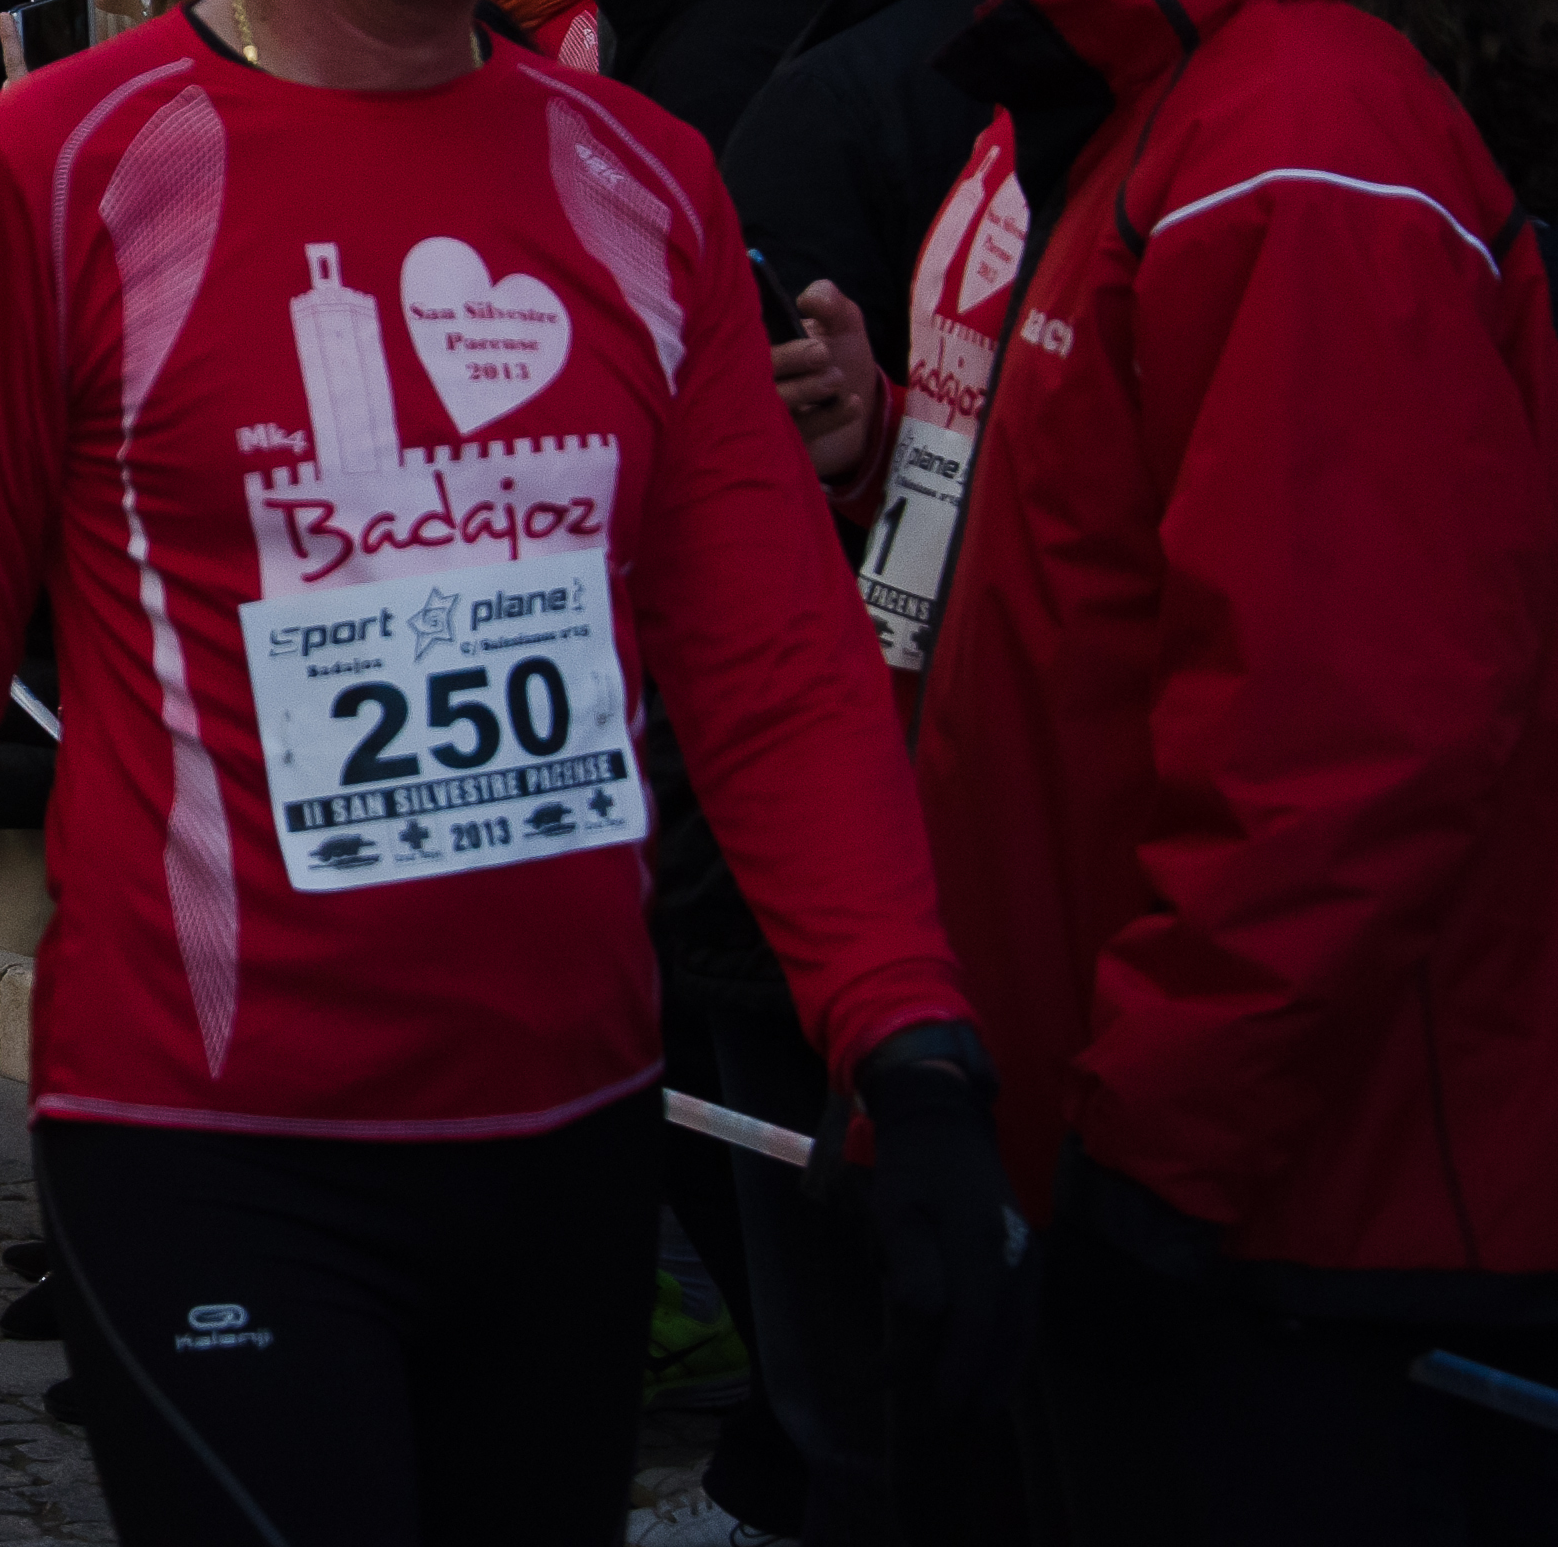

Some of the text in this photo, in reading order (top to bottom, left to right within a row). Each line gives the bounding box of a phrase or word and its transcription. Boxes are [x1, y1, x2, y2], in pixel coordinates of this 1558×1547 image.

[411, 301, 558, 325] San Silvestre
[446, 332, 540, 352] Pacense
[465, 362, 531, 381] 2013
[263, 470, 602, 582] Badajoz
[306, 658, 383, 678] Badajoz
[330, 654, 571, 787] 250
[302, 753, 613, 828] II SAN SILVESTRE PACENSE
[450, 815, 512, 853] 2013
